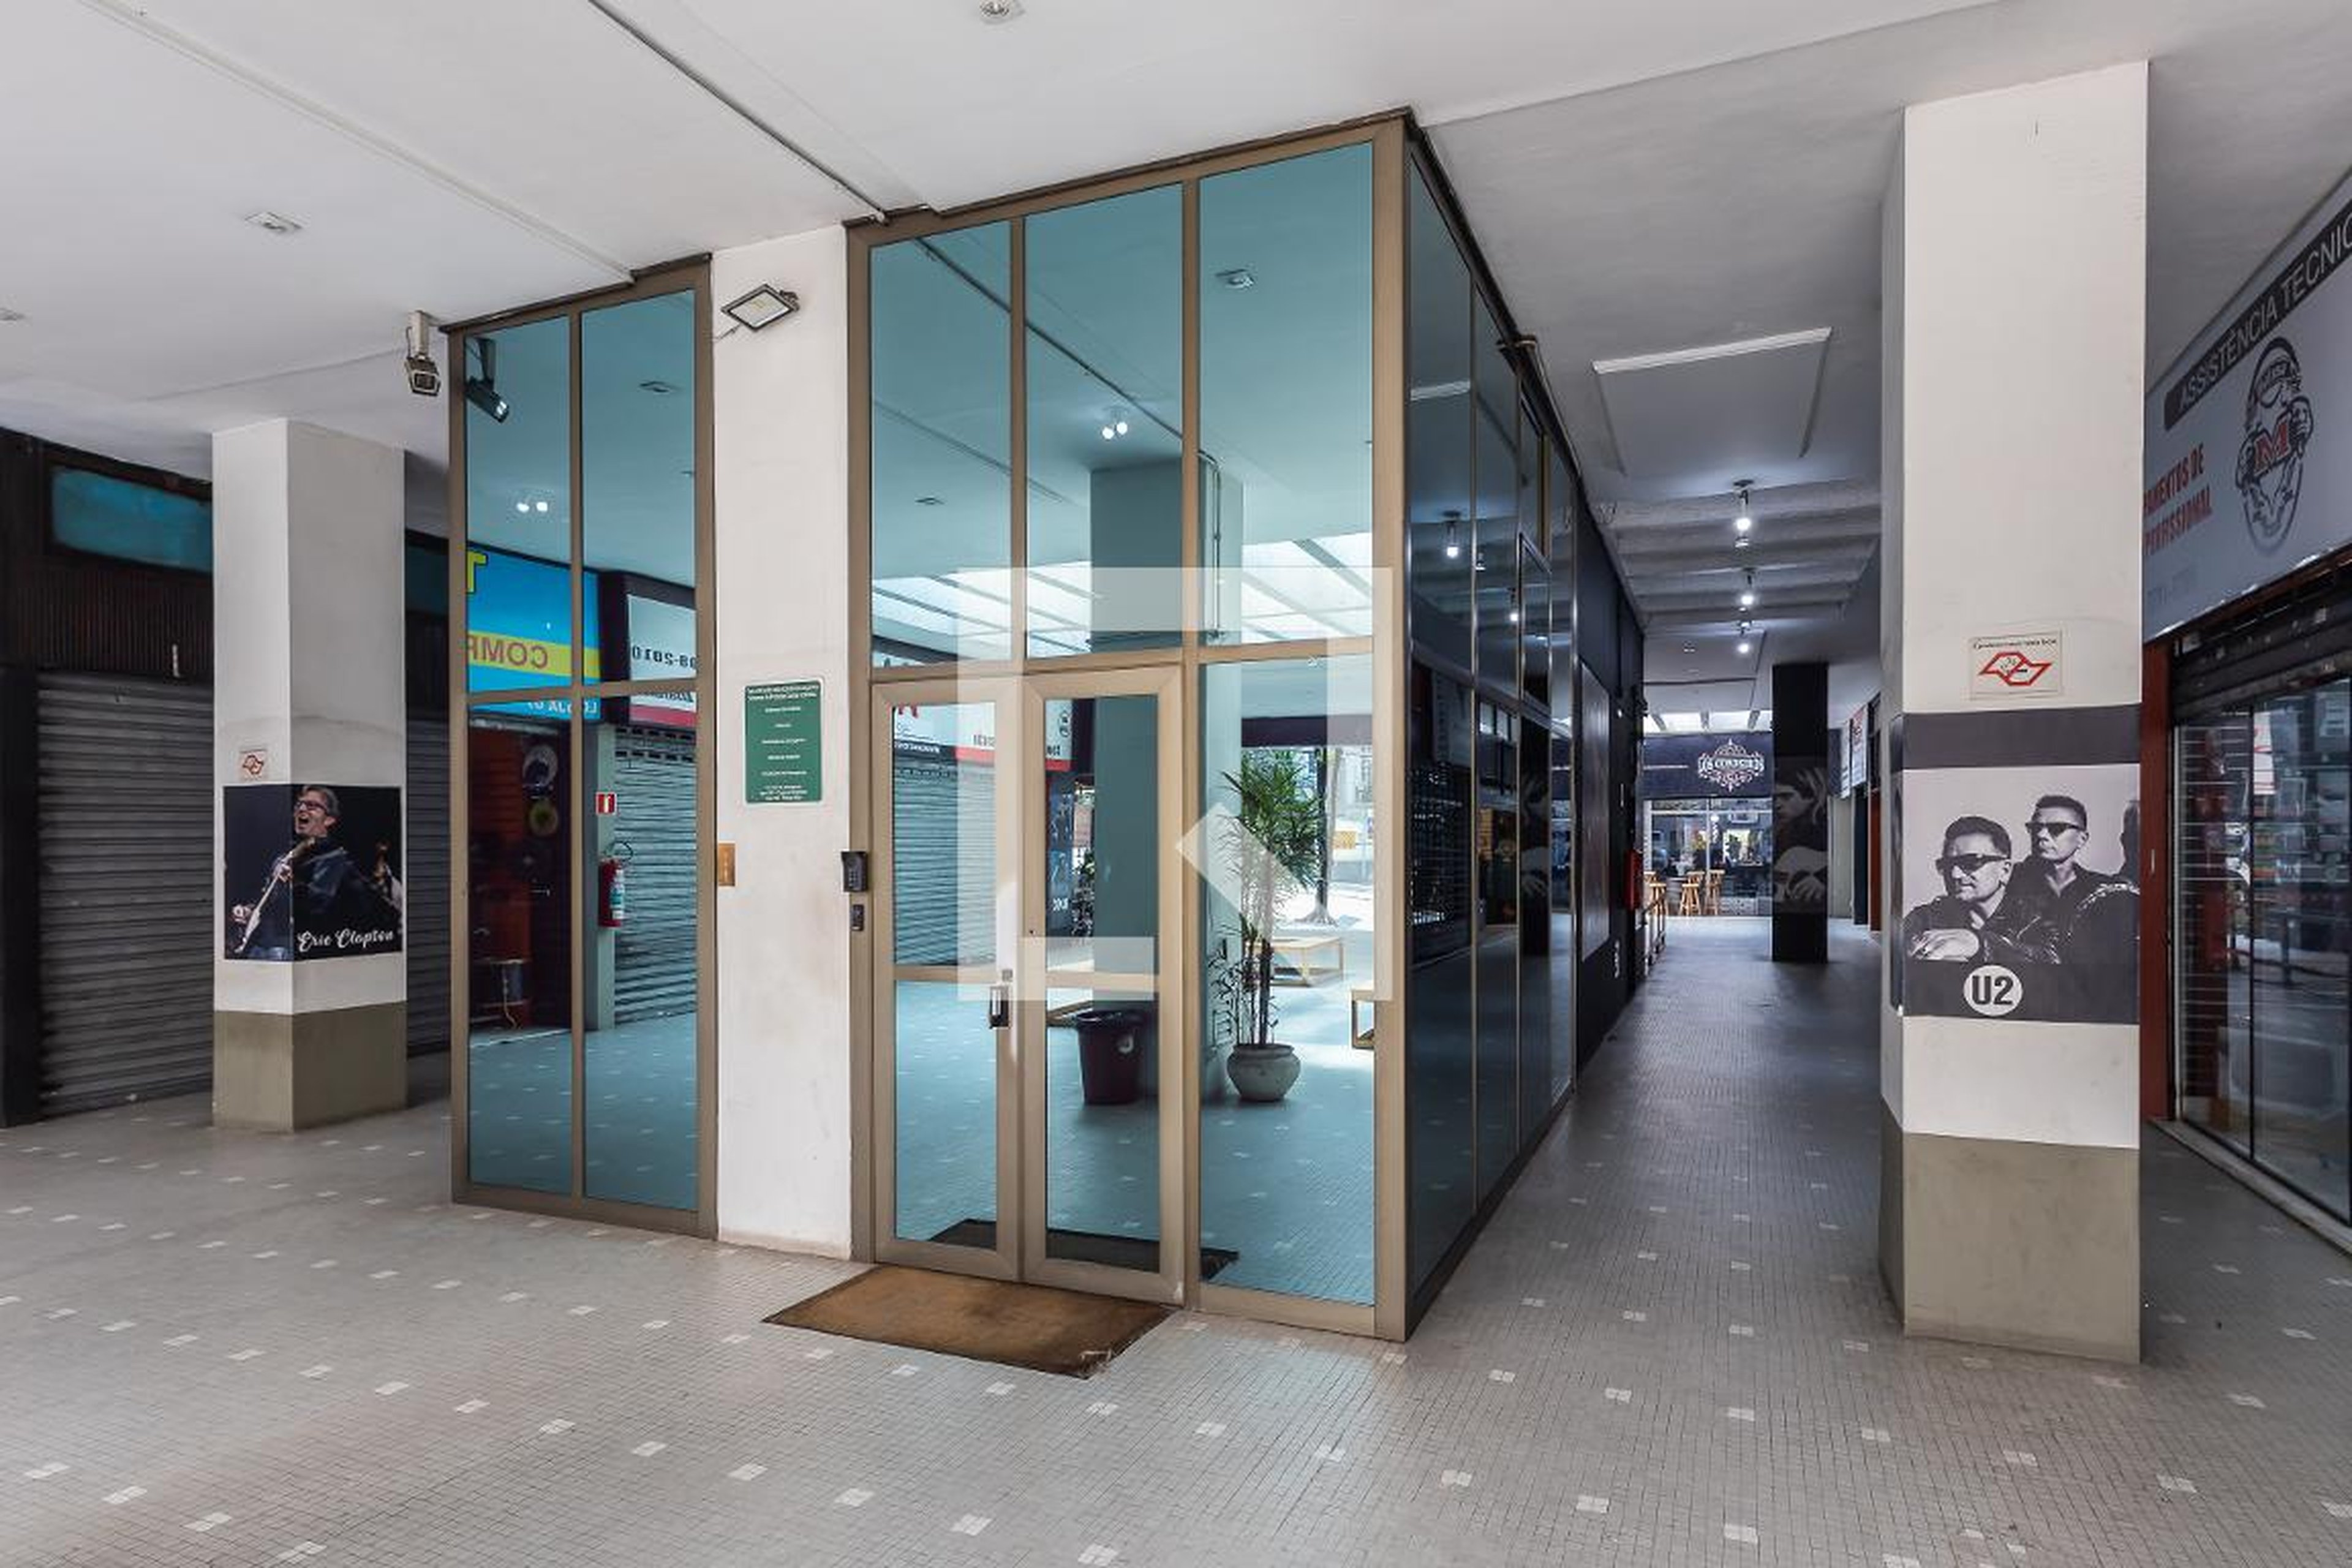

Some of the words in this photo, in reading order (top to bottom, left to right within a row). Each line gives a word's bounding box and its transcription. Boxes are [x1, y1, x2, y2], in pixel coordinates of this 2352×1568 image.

[297, 930, 333, 952] Eric
[335, 928, 393, 948] Clapton
[1972, 975, 2013, 1005] U2
